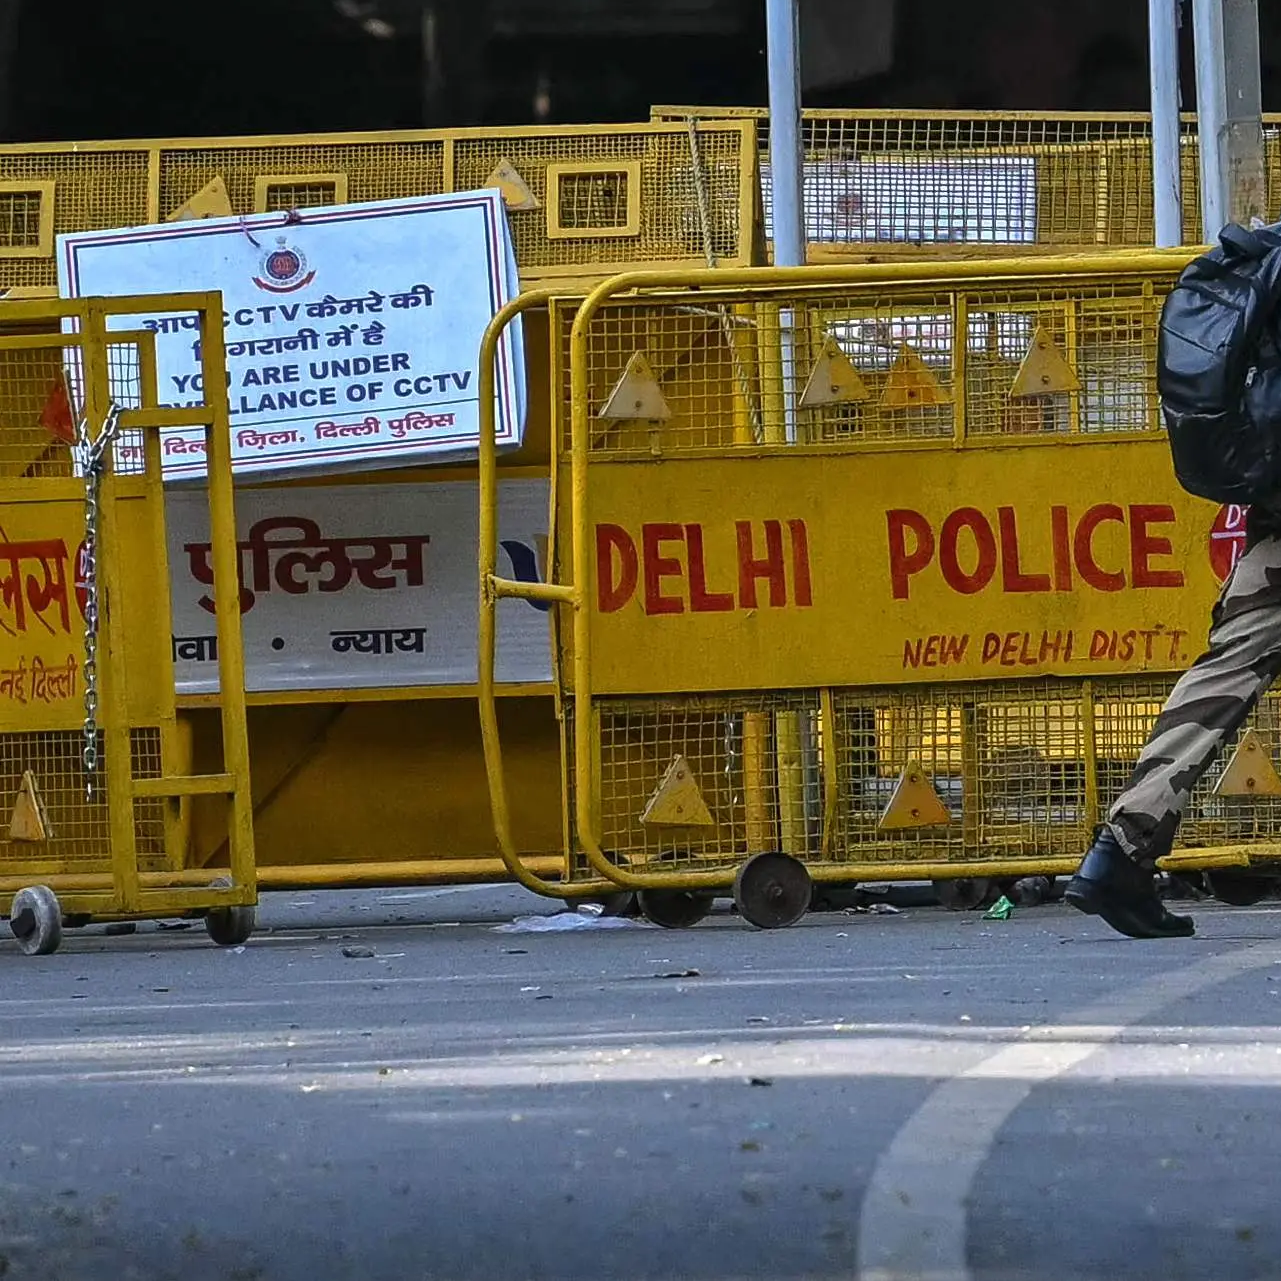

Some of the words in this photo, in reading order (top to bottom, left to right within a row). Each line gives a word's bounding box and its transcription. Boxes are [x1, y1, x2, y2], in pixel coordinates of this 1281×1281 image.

[305, 290, 386, 319] कैमरे
[389, 284, 435, 309] की
[325, 323, 359, 348] में
[361, 320, 386, 346] है
[242, 364, 300, 387] ARE
[309, 352, 411, 380] UNDER
[346, 381, 384, 403] OF
[393, 370, 473, 398] CCTV
[314, 416, 381, 439] दिल्ली
[387, 411, 456, 437] पुलिस
[596, 519, 813, 616] DELHI
[886, 504, 1185, 600] POLICE
[329, 627, 427, 655] न्याय
[902, 632, 969, 668] NEW
[982, 628, 1074, 666] DELHI
[31, 653, 78, 704] दिल्ली
